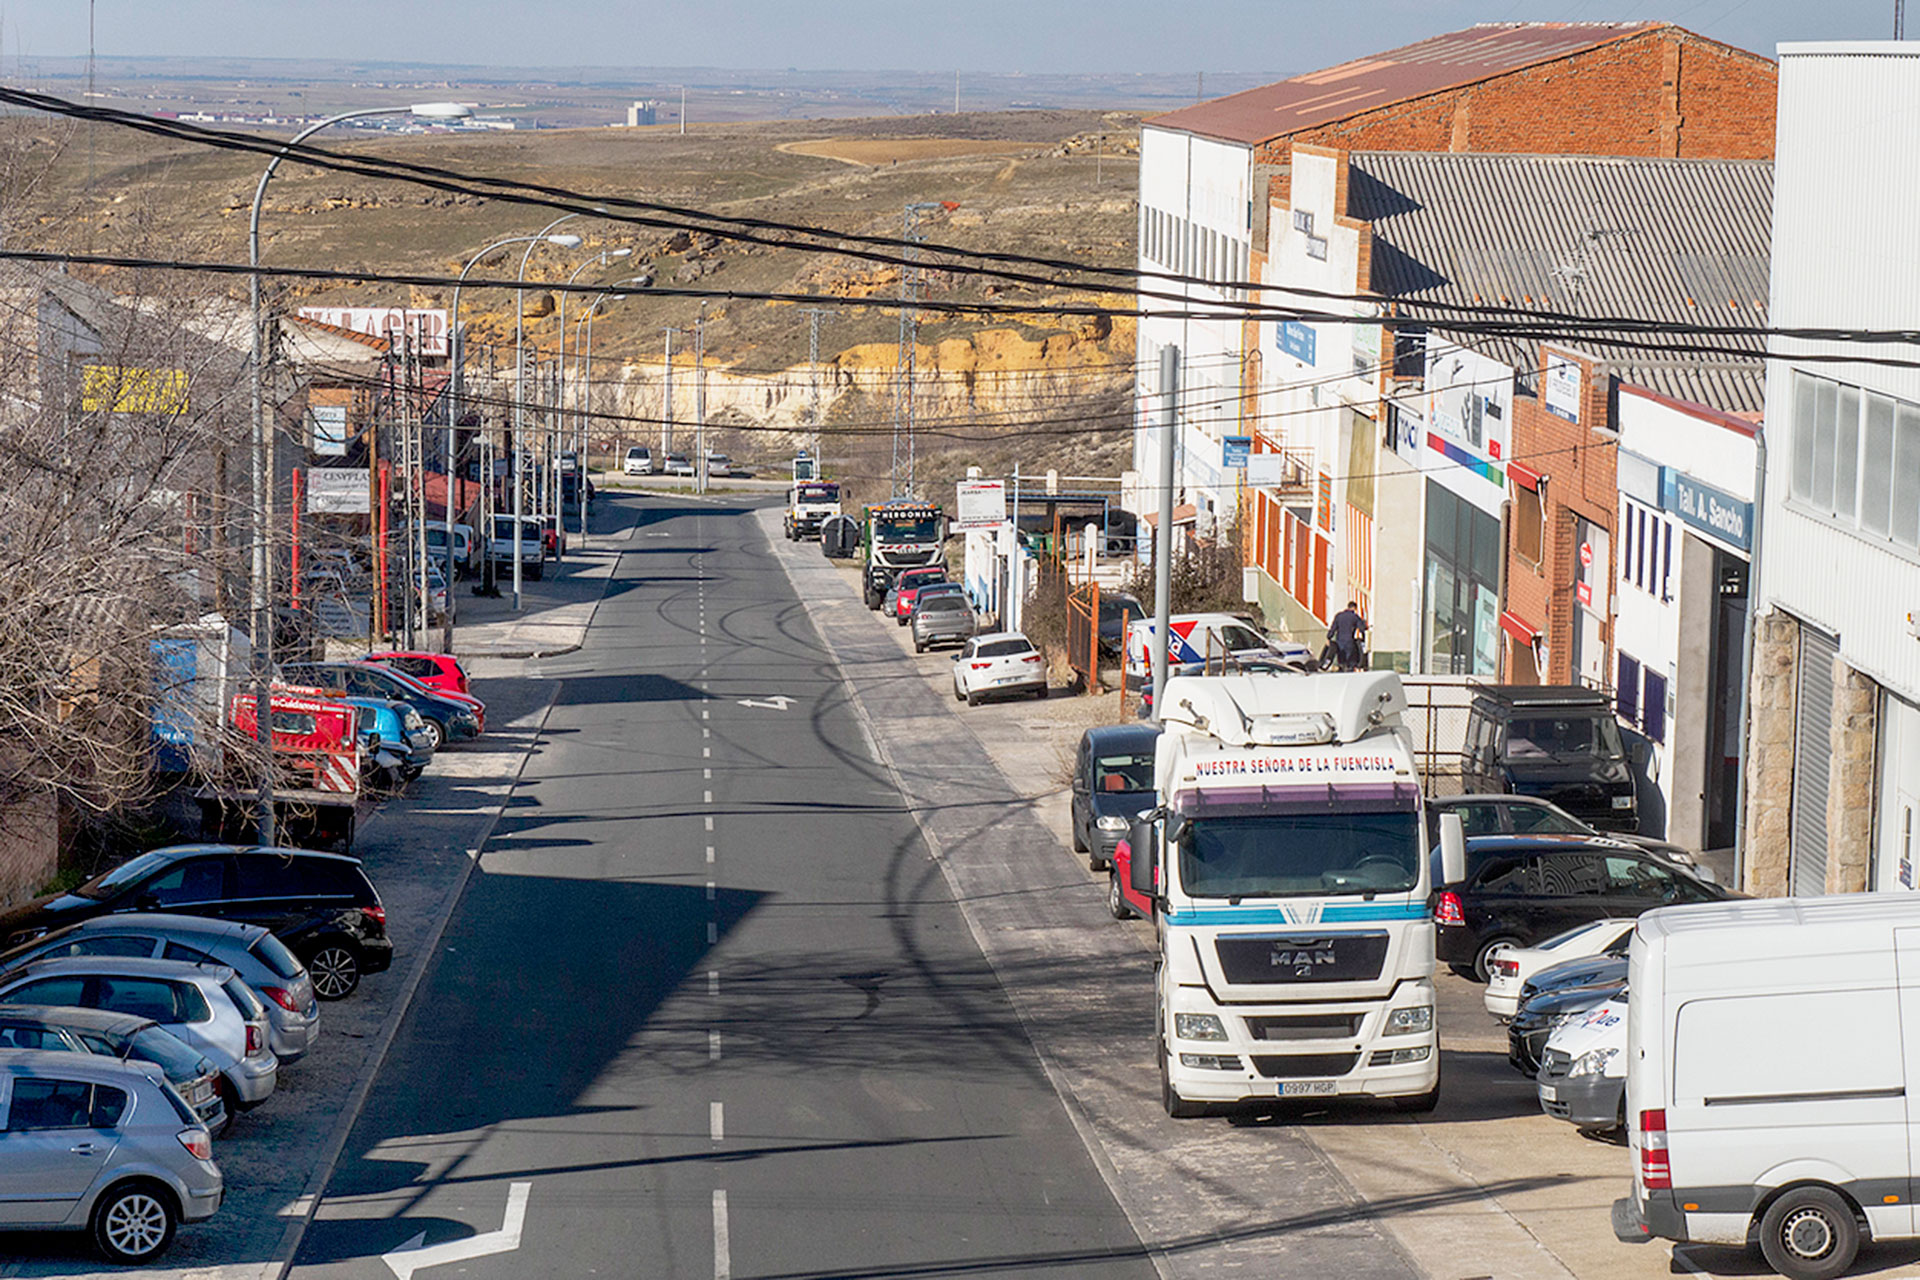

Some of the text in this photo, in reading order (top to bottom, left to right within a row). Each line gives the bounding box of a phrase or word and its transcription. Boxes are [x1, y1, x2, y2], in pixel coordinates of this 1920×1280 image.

[1709, 496, 1744, 539] Sancho
[1196, 756, 1396, 777] NUESTRA SEÑORA DE LA FUENCISLA
[1271, 951, 1336, 966] MAN
[1284, 1081, 1334, 1095] 0997 HGP
